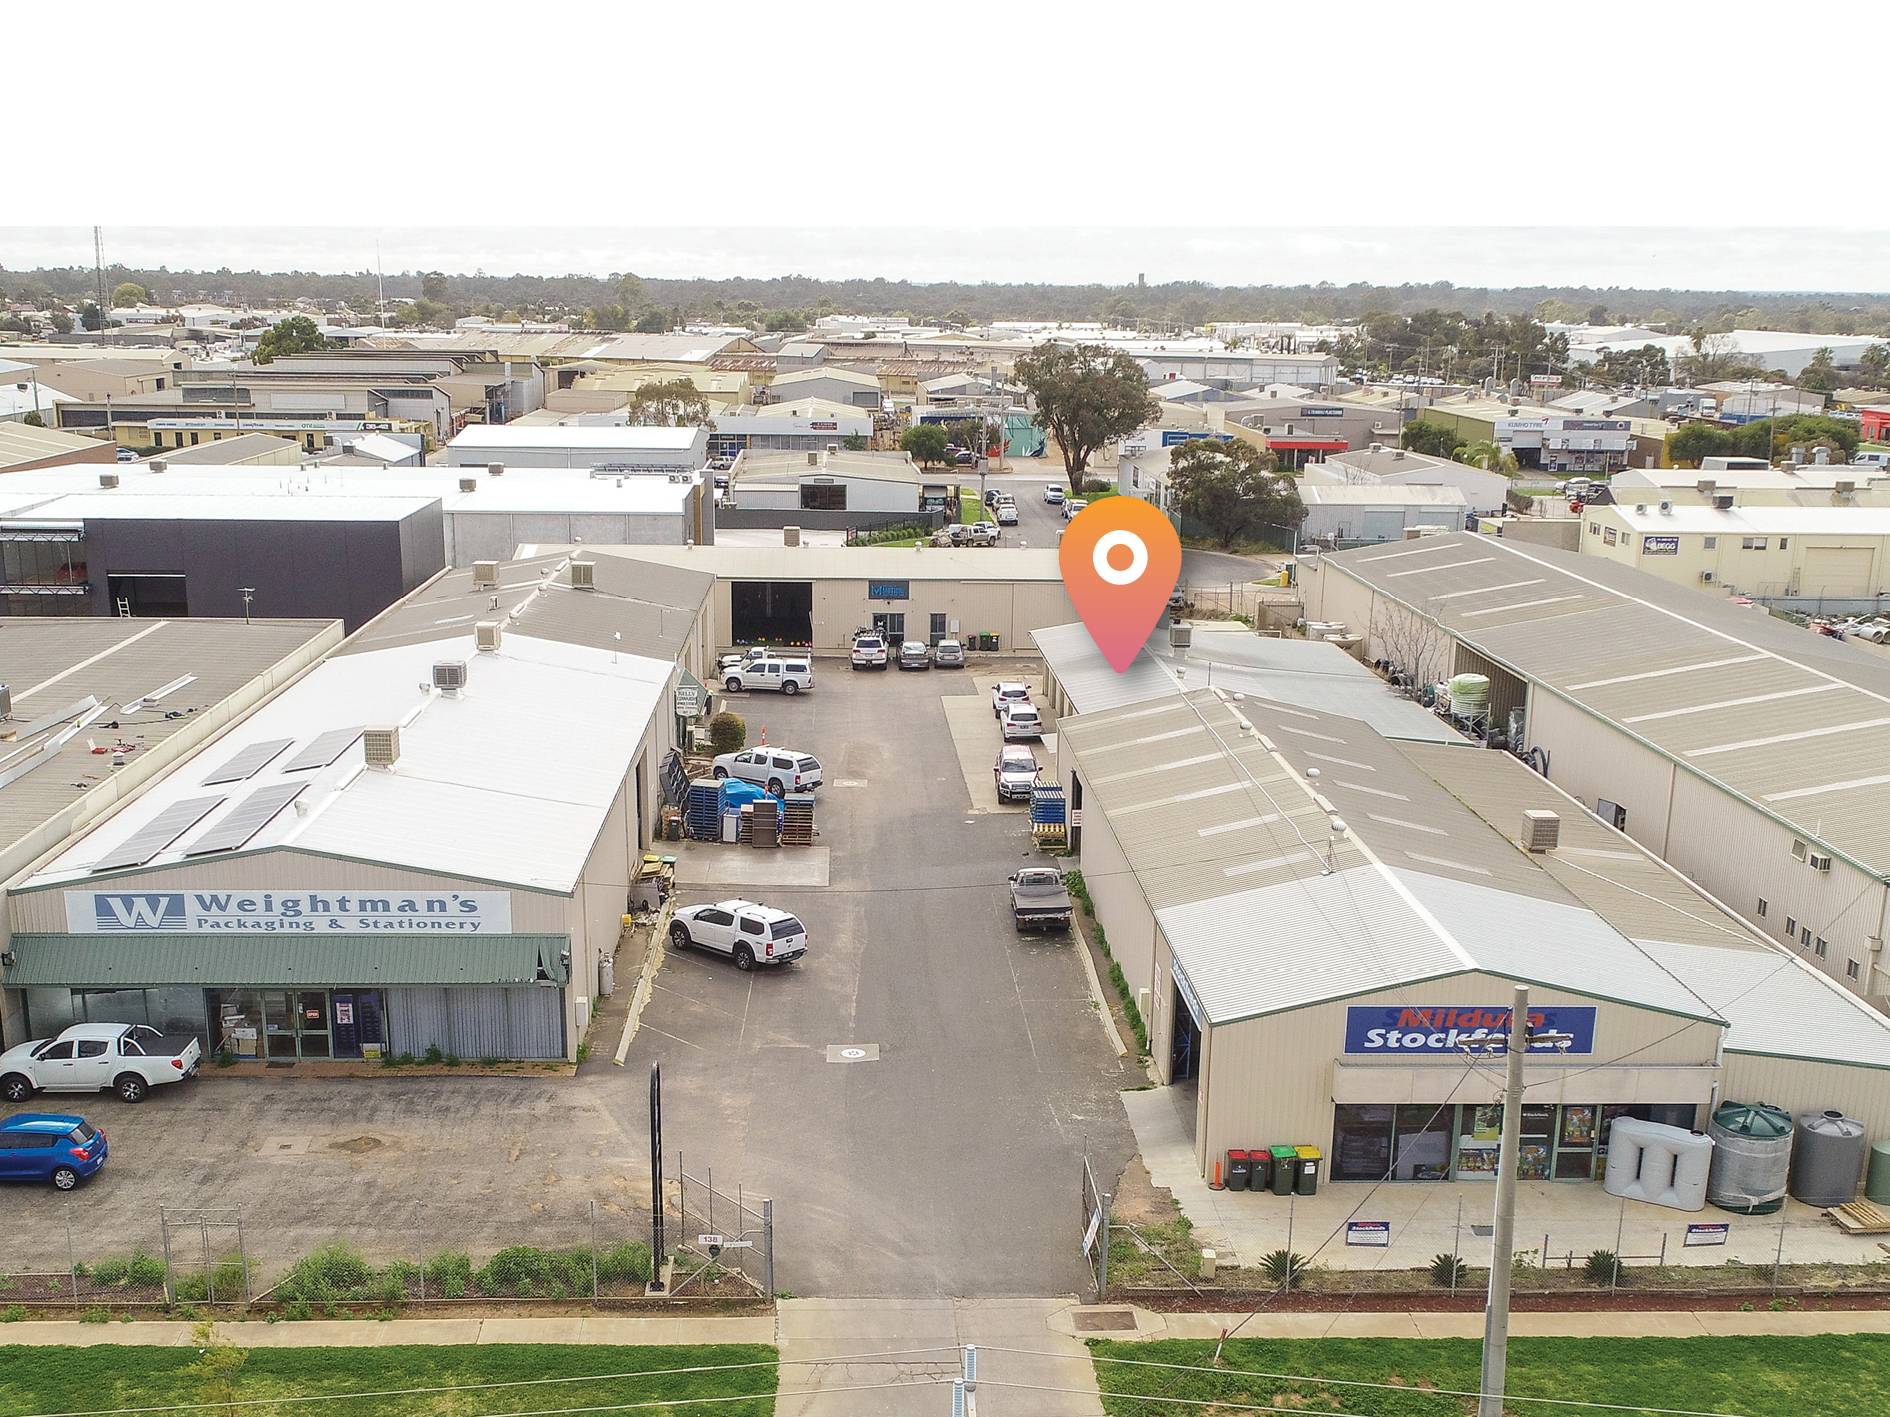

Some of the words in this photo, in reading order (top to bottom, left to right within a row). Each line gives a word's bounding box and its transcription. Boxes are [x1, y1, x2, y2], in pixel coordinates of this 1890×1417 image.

[104, 896, 170, 929] W
[194, 894, 479, 918] Weightman's
[196, 918, 316, 932] Packaging
[328, 918, 345, 930] &
[358, 918, 481, 932] Stationery
[1364, 1028, 1574, 1049] Stockfeds
